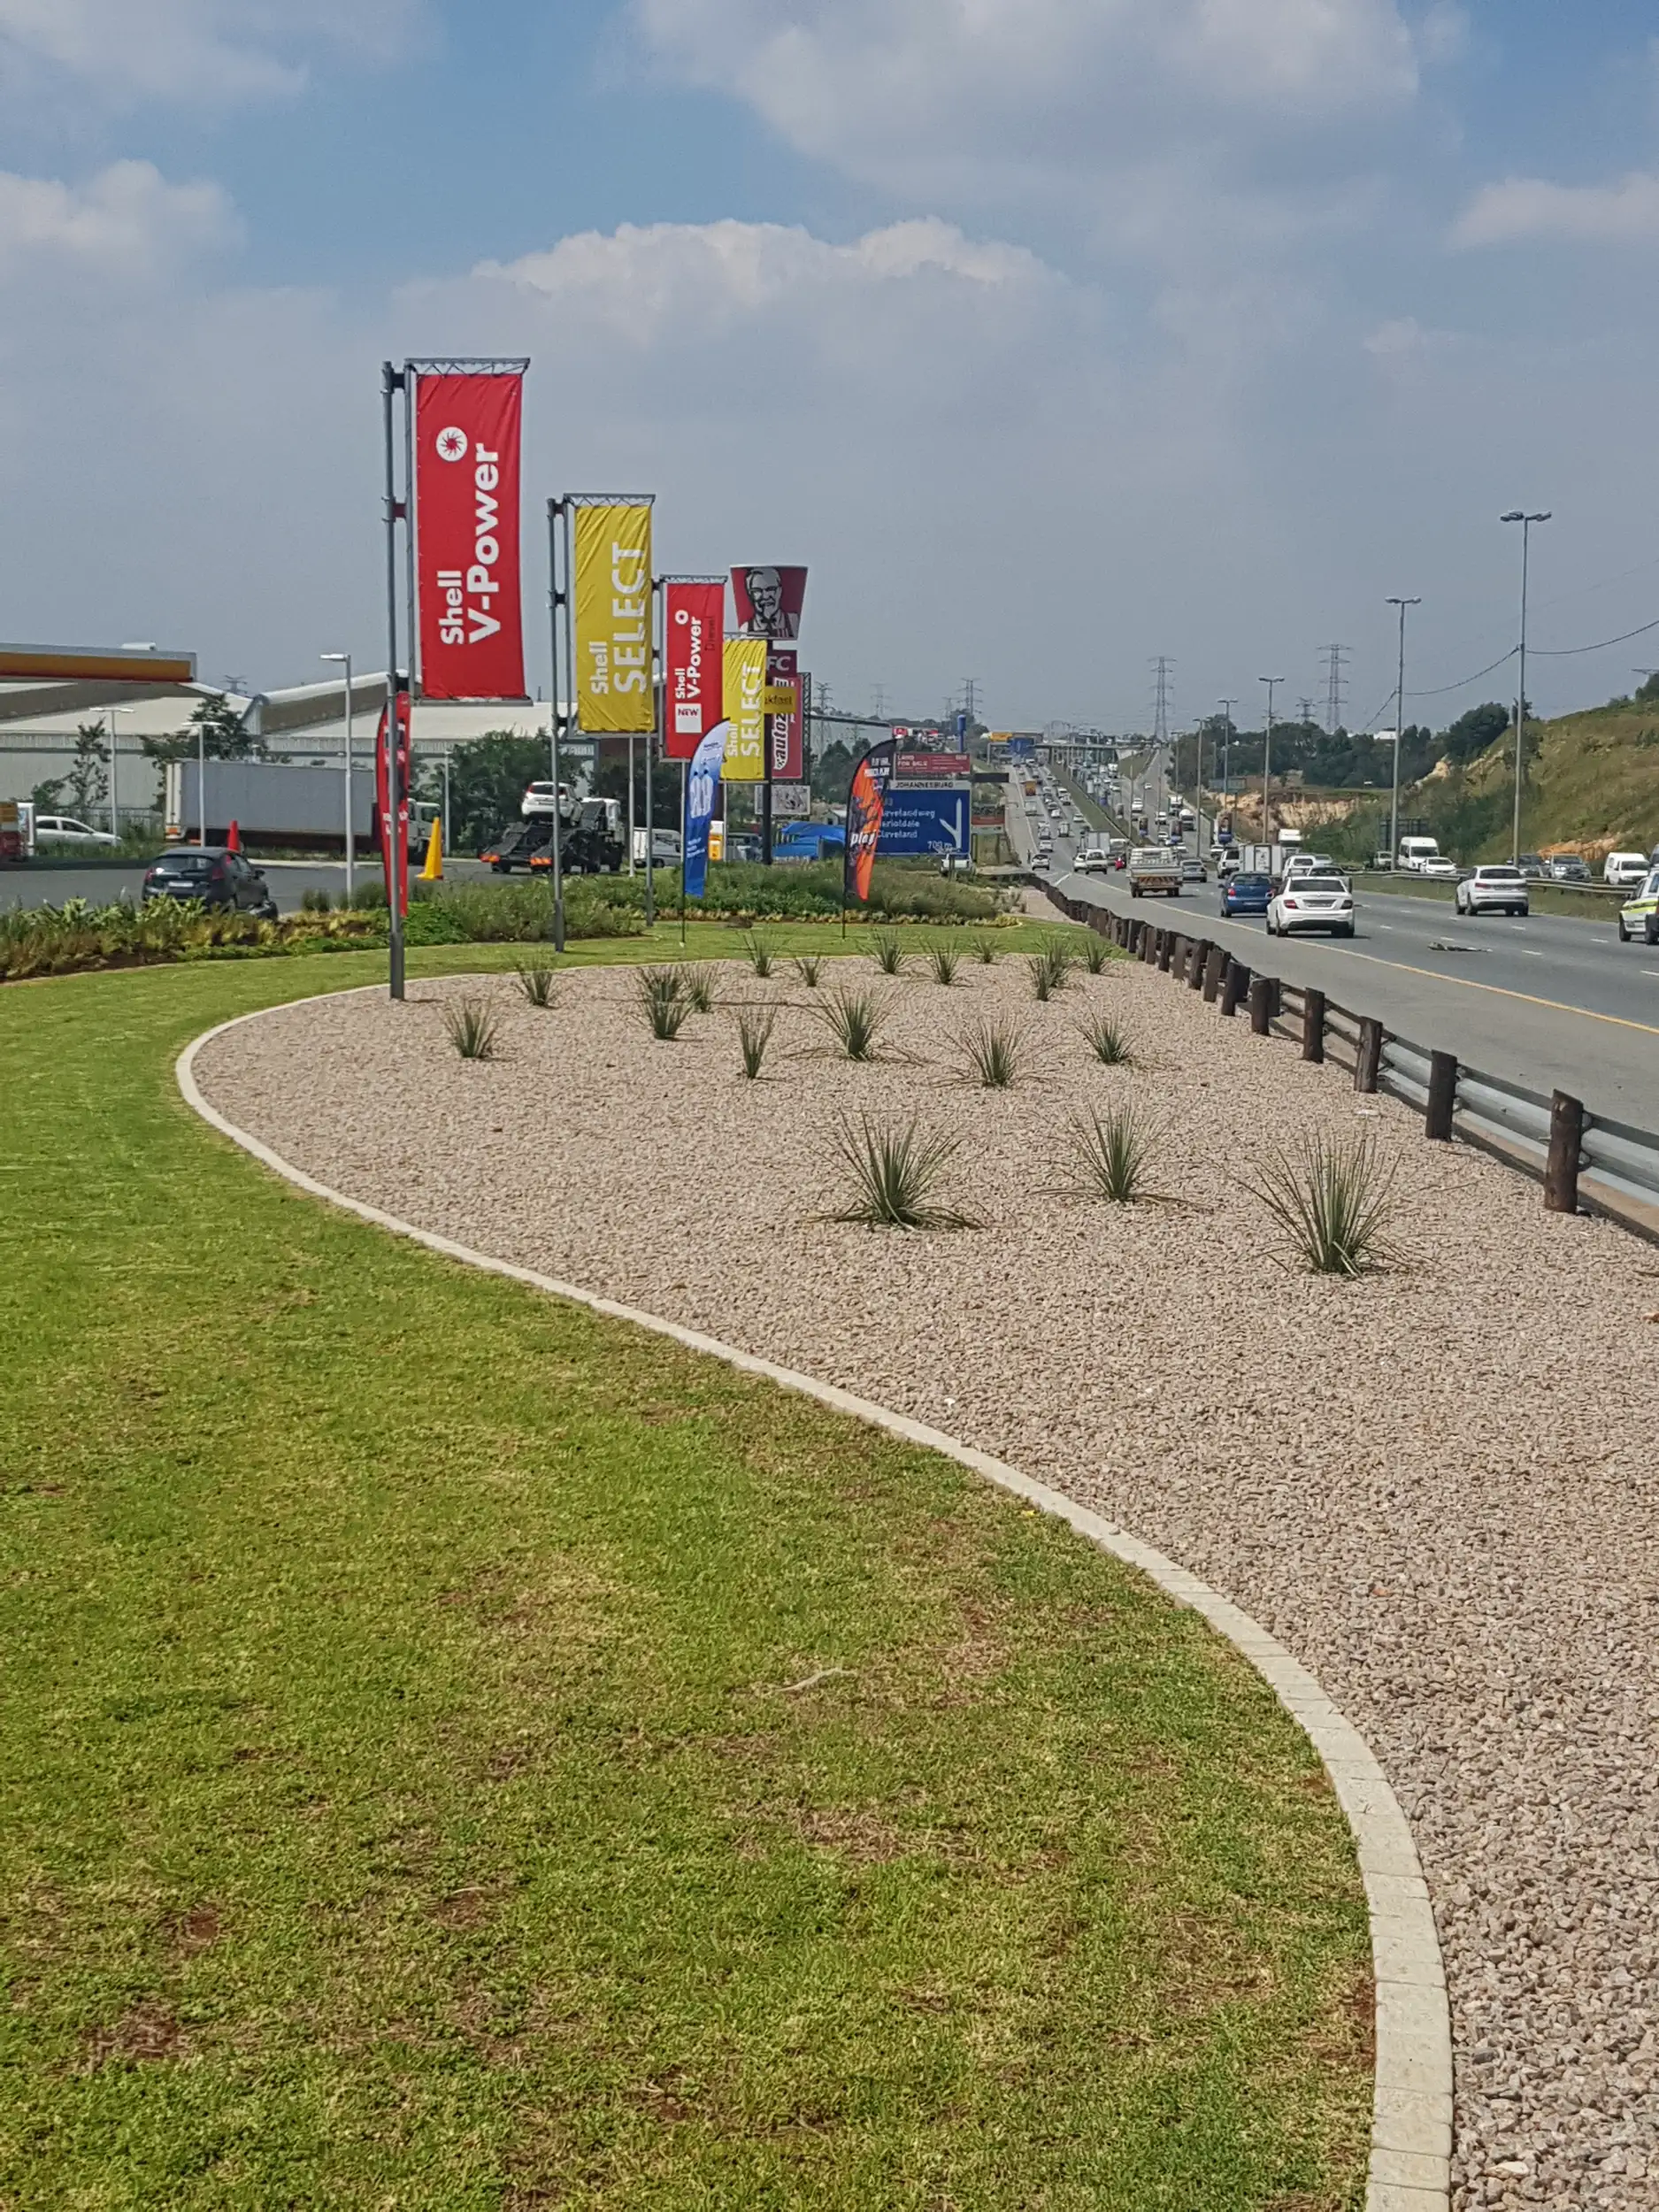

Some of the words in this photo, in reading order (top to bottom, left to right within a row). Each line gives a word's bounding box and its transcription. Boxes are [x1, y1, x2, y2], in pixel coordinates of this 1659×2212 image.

[466, 442, 502, 644] V-Power
[437, 571, 465, 645] Shell
[611, 541, 647, 693] SELECT
[588, 641, 609, 695] Shell
[674, 668, 686, 699] Shell
[687, 617, 703, 699] V-Power
[766, 656, 791, 672] FC
[726, 723, 739, 758] Shell
[741, 661, 762, 757] SELECT
